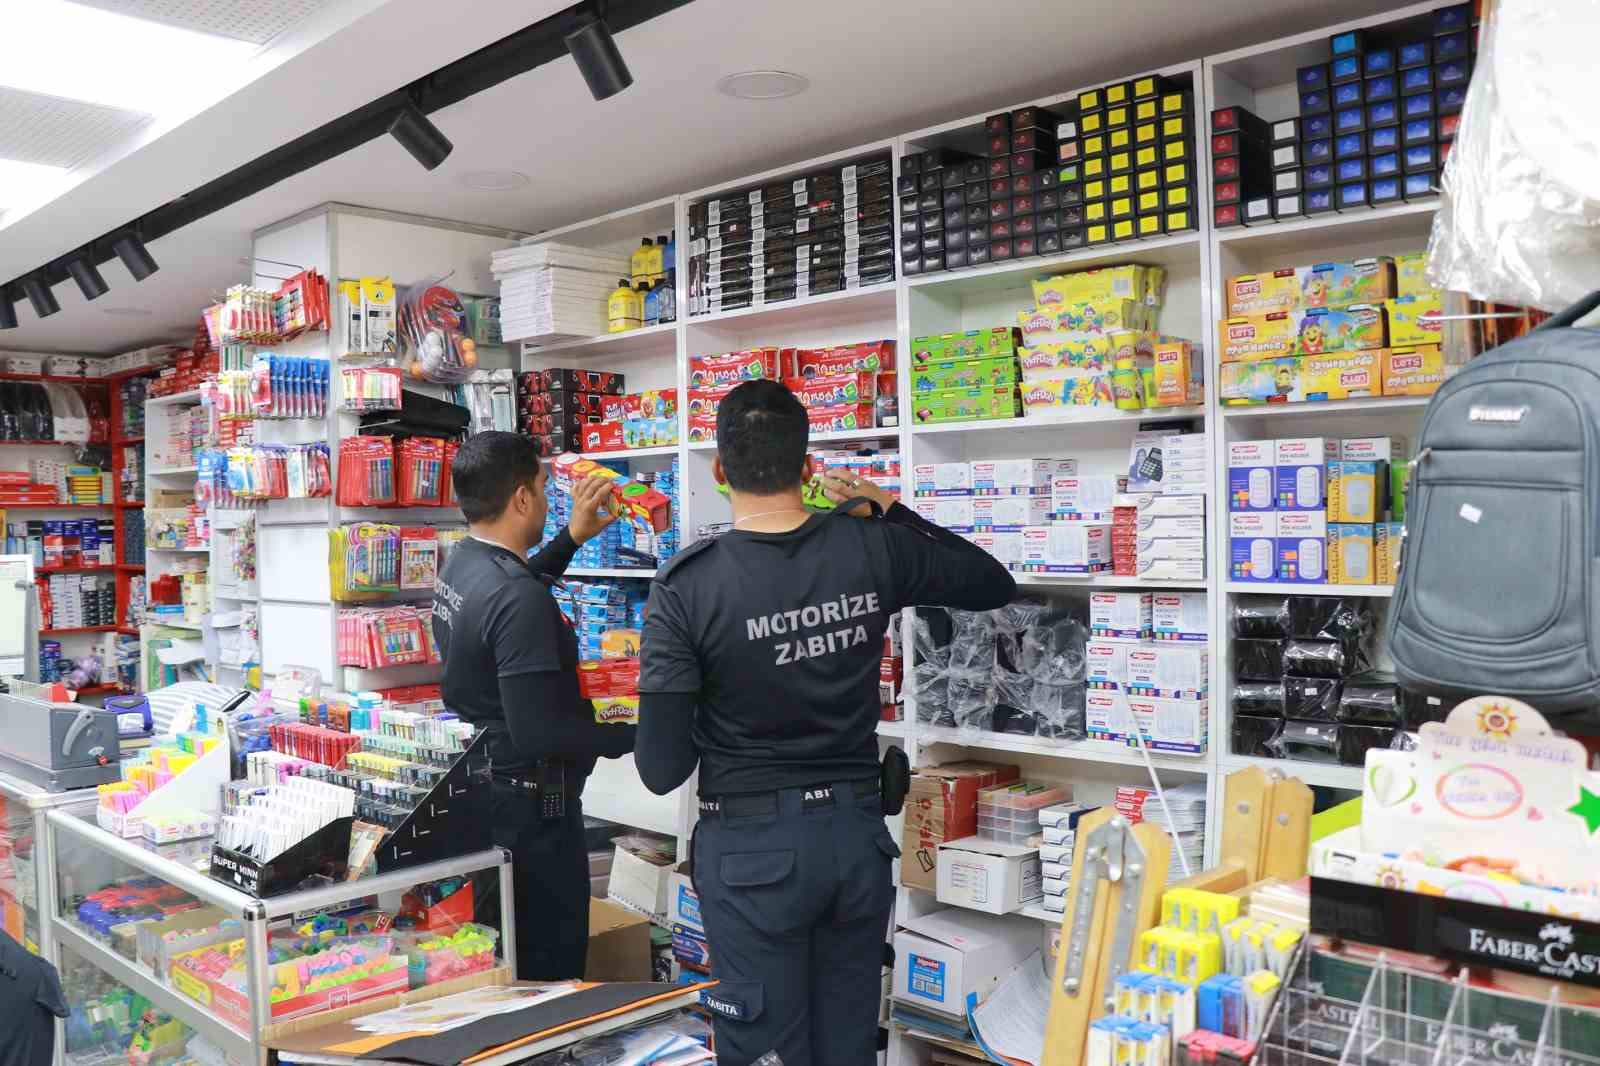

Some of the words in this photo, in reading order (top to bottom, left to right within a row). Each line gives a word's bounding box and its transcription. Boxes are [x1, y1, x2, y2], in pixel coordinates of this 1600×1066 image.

[746, 592, 880, 640] MOTORİZE
[775, 624, 868, 666] ZABITA
[800, 787, 832, 801] ABI
[213, 854, 237, 871] SUPER
[706, 996, 738, 1015] ZABITA
